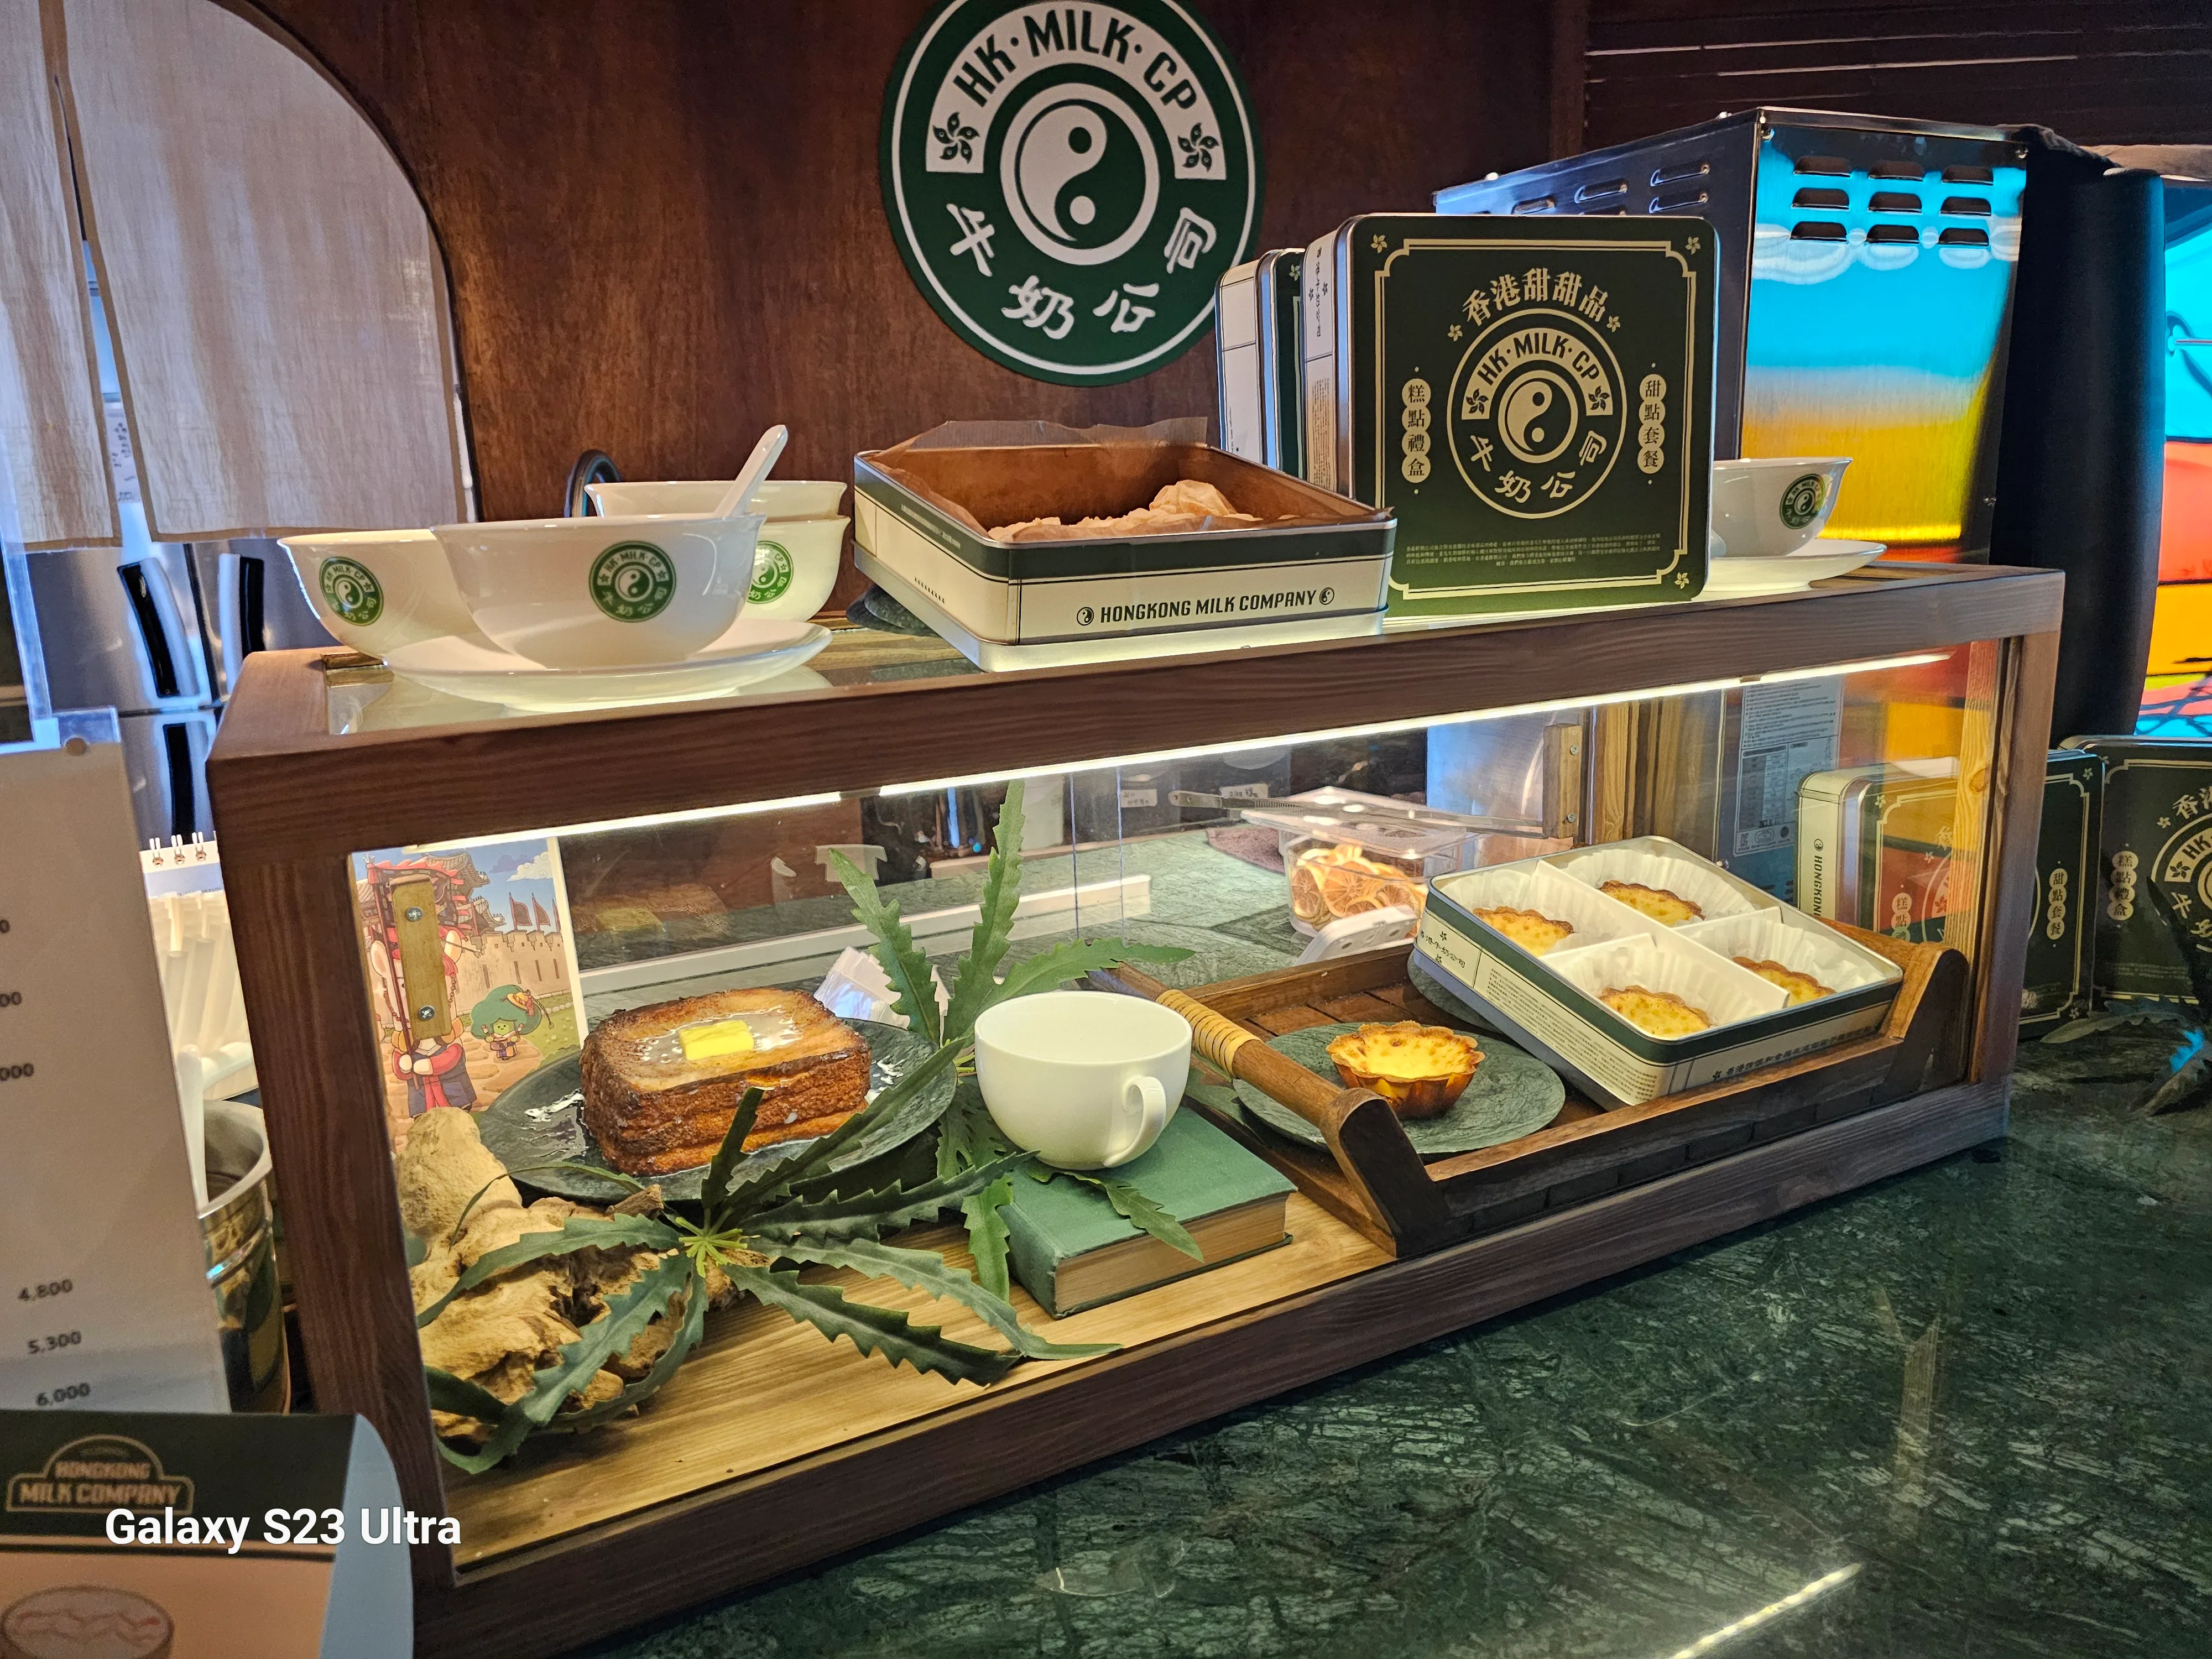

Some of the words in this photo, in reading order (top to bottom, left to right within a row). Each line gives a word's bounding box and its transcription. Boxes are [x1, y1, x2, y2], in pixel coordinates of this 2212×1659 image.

[946, 204, 1216, 340] 牛奶公司
[1462, 267, 1608, 326] 香港甜甜品
[1407, 384, 1425, 476] 糕點禮盒
[1643, 380, 1661, 467] 甜點套餐
[1470, 430, 1607, 503] 牛奶公司
[1100, 600, 1191, 623] HONGKONG
[1195, 596, 1236, 615] MILK
[1239, 589, 1318, 612] COMPANY
[20, 1483, 72, 1504] MILK
[76, 1483, 181, 1505] COMPANY
